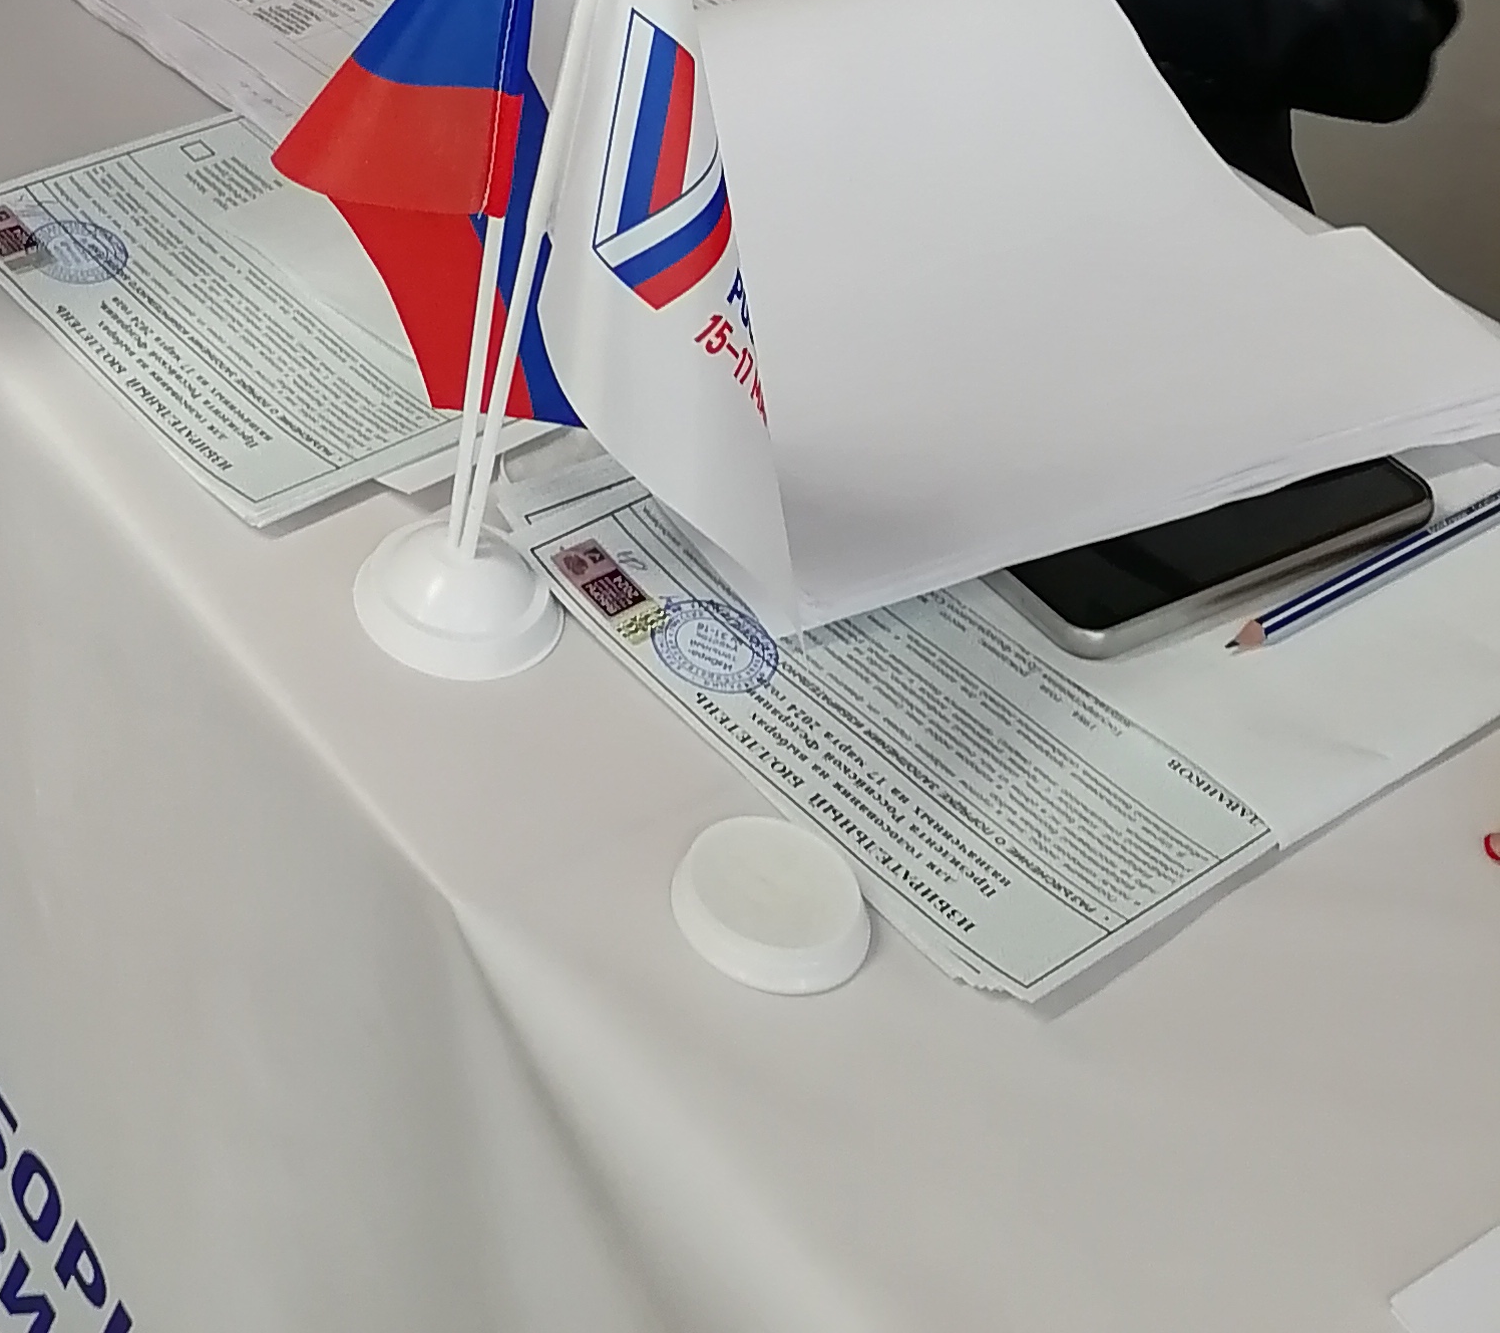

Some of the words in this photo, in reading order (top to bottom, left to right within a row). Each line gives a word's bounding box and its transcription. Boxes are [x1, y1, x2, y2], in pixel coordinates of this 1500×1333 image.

[126, 377, 232, 470] ИЗБИРАТЕЛЬНЫЙ
[697, 691, 804, 788] БЮЛЛЕТЕНЬ
[751, 712, 809, 762] выборах
[785, 703, 820, 730] 2024
[821, 731, 866, 767] марта
[821, 751, 905, 823] Российской
[864, 769, 887, 785] 17
[831, 781, 923, 859] голосования
[806, 792, 976, 932] ИЗБИРАТЕЛЬНЫЙ
[907, 823, 997, 898] Президента
